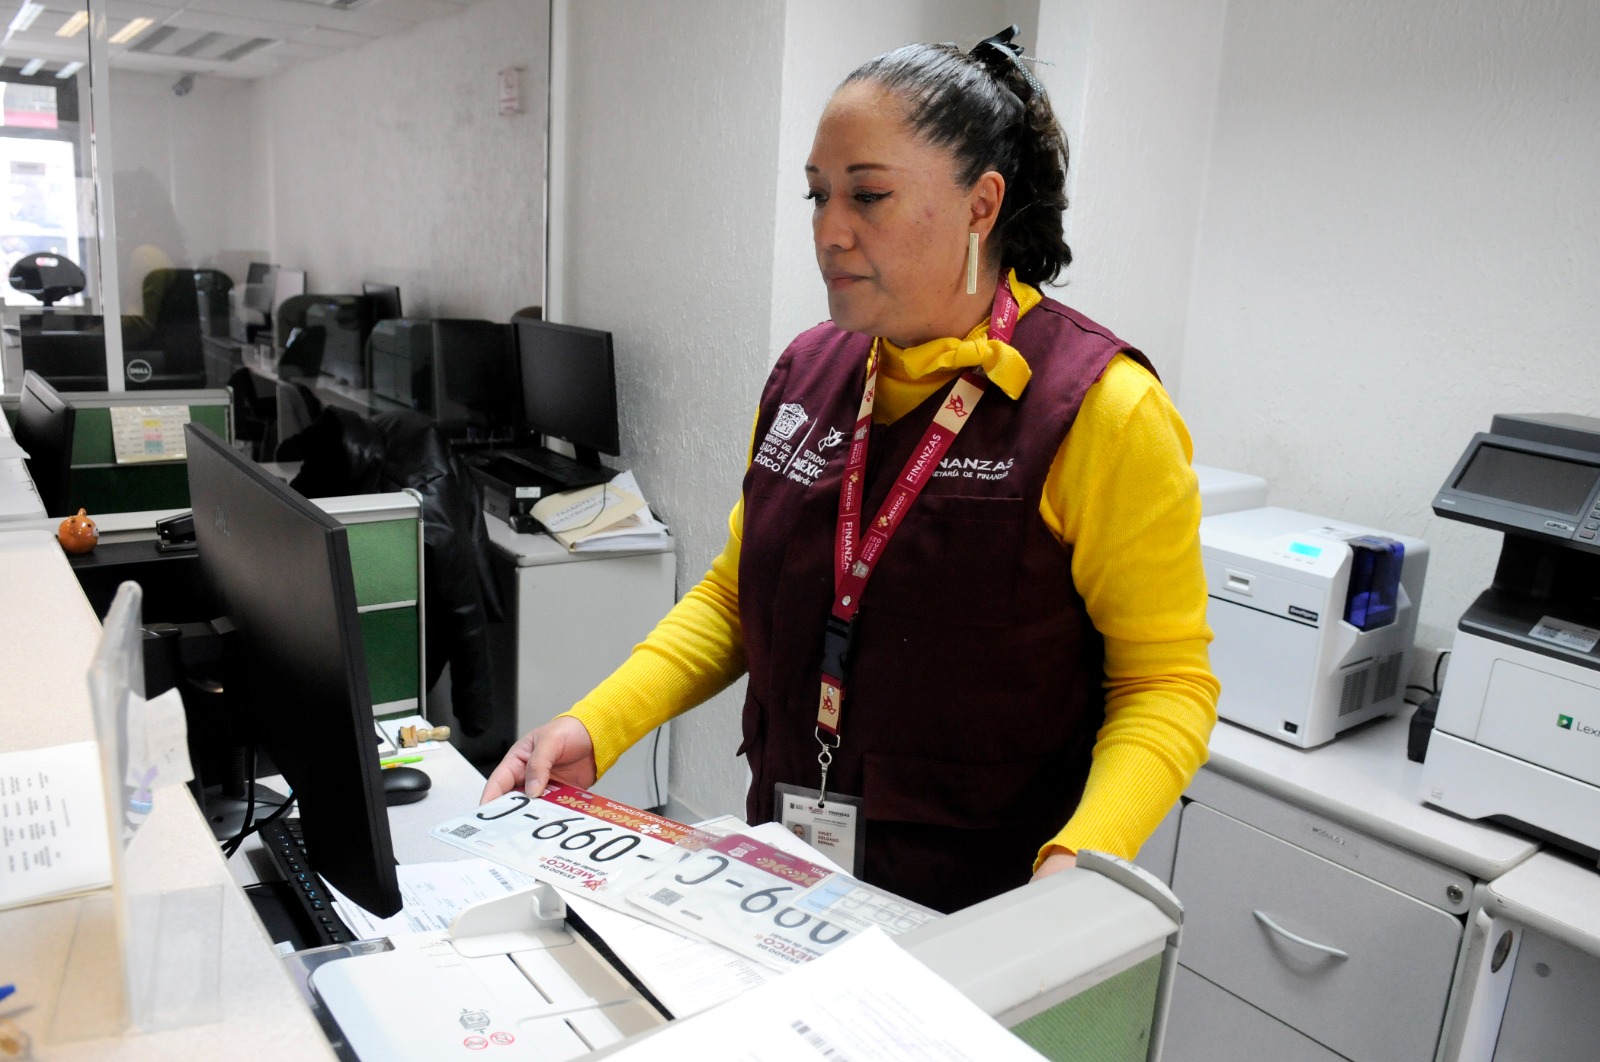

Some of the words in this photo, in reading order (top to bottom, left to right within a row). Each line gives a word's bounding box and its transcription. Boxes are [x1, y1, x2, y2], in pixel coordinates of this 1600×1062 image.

[906, 433, 942, 482] FINANZAS
[887, 495, 905, 521] MEXICO
[842, 521, 854, 573] FINANZA
[476, 796, 691, 862] -099-C
[549, 867, 576, 879] ESTADO
